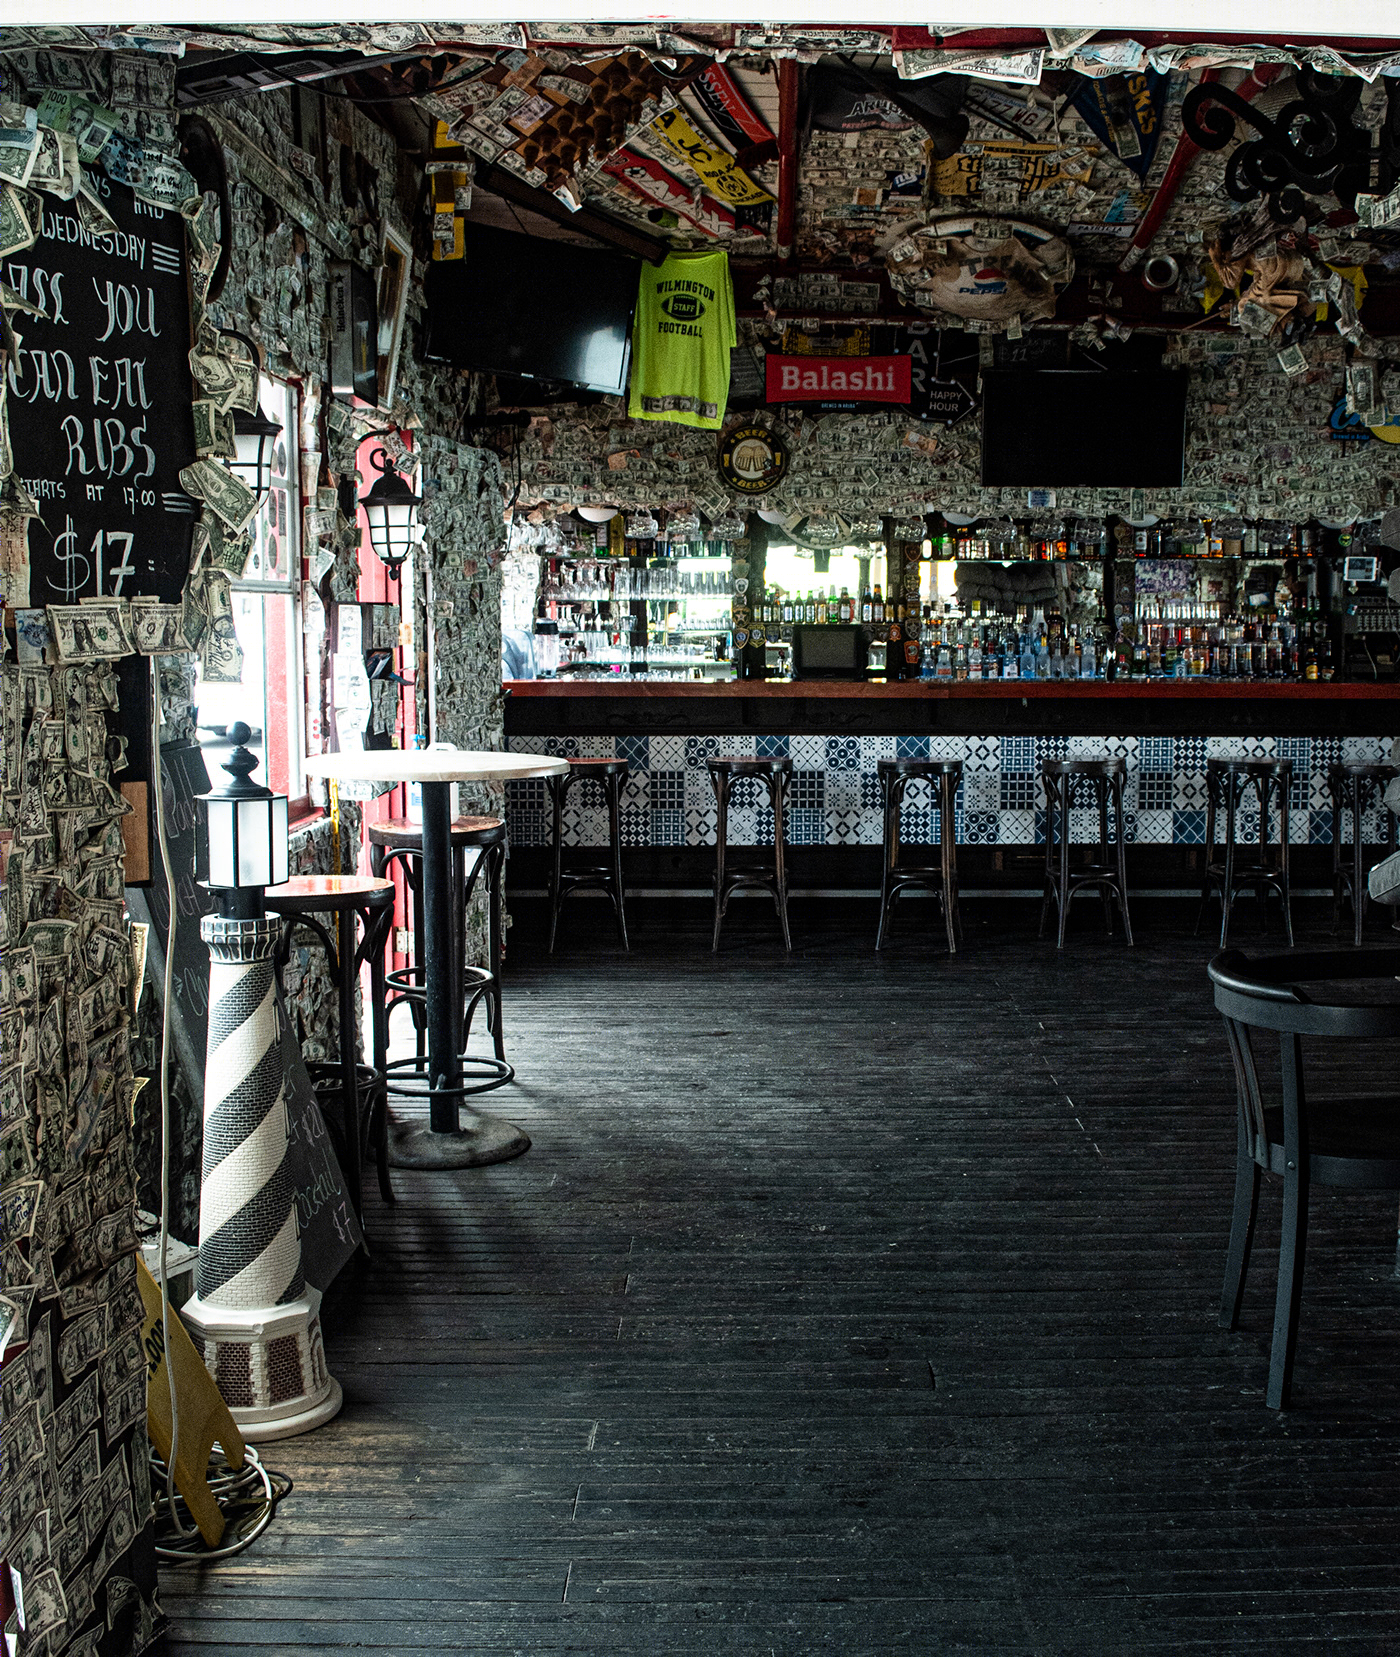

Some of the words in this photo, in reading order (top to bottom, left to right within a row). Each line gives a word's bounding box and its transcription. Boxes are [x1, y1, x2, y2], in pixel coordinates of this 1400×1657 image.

[50, 90, 68, 105] 1000
[678, 138, 712, 164] JC
[656, 279, 716, 302] WILMINGTON
[958, 287, 1008, 295] PEPSI
[92, 277, 162, 342] YOU
[336, 285, 346, 333] Heineken
[673, 302, 696, 313] STAFF
[658, 321, 703, 338] FOOTBALL
[89, 355, 153, 410] EAT
[780, 365, 896, 391] Balashi
[930, 390, 963, 400] HAPPY
[929, 401, 959, 411] HOUR
[735, 428, 768, 440] BEER
[60, 413, 156, 489] RIBS
[86, 484, 104, 502] AT
[737, 479, 768, 489] BEER
[46, 513, 136, 602] $17
